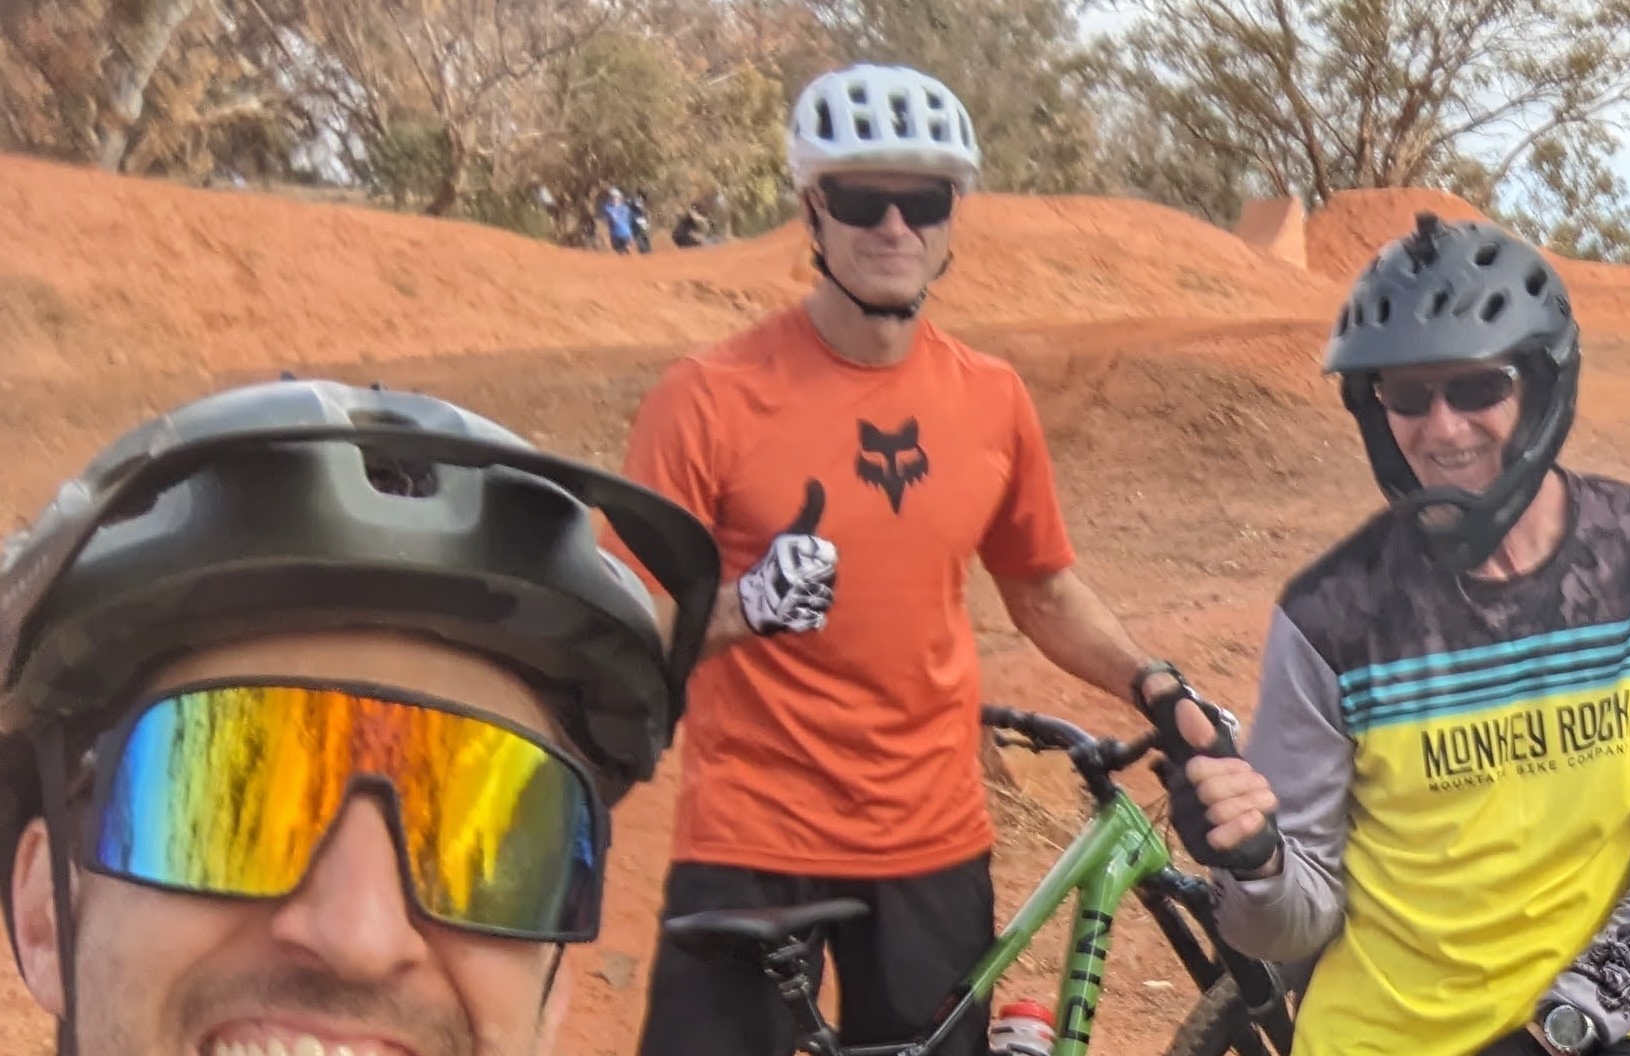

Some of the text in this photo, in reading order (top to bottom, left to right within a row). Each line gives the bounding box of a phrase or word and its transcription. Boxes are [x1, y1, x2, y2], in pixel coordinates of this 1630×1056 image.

[1421, 689, 1630, 779] MONKEY ROCK
[1516, 759, 1558, 775] BIKE
